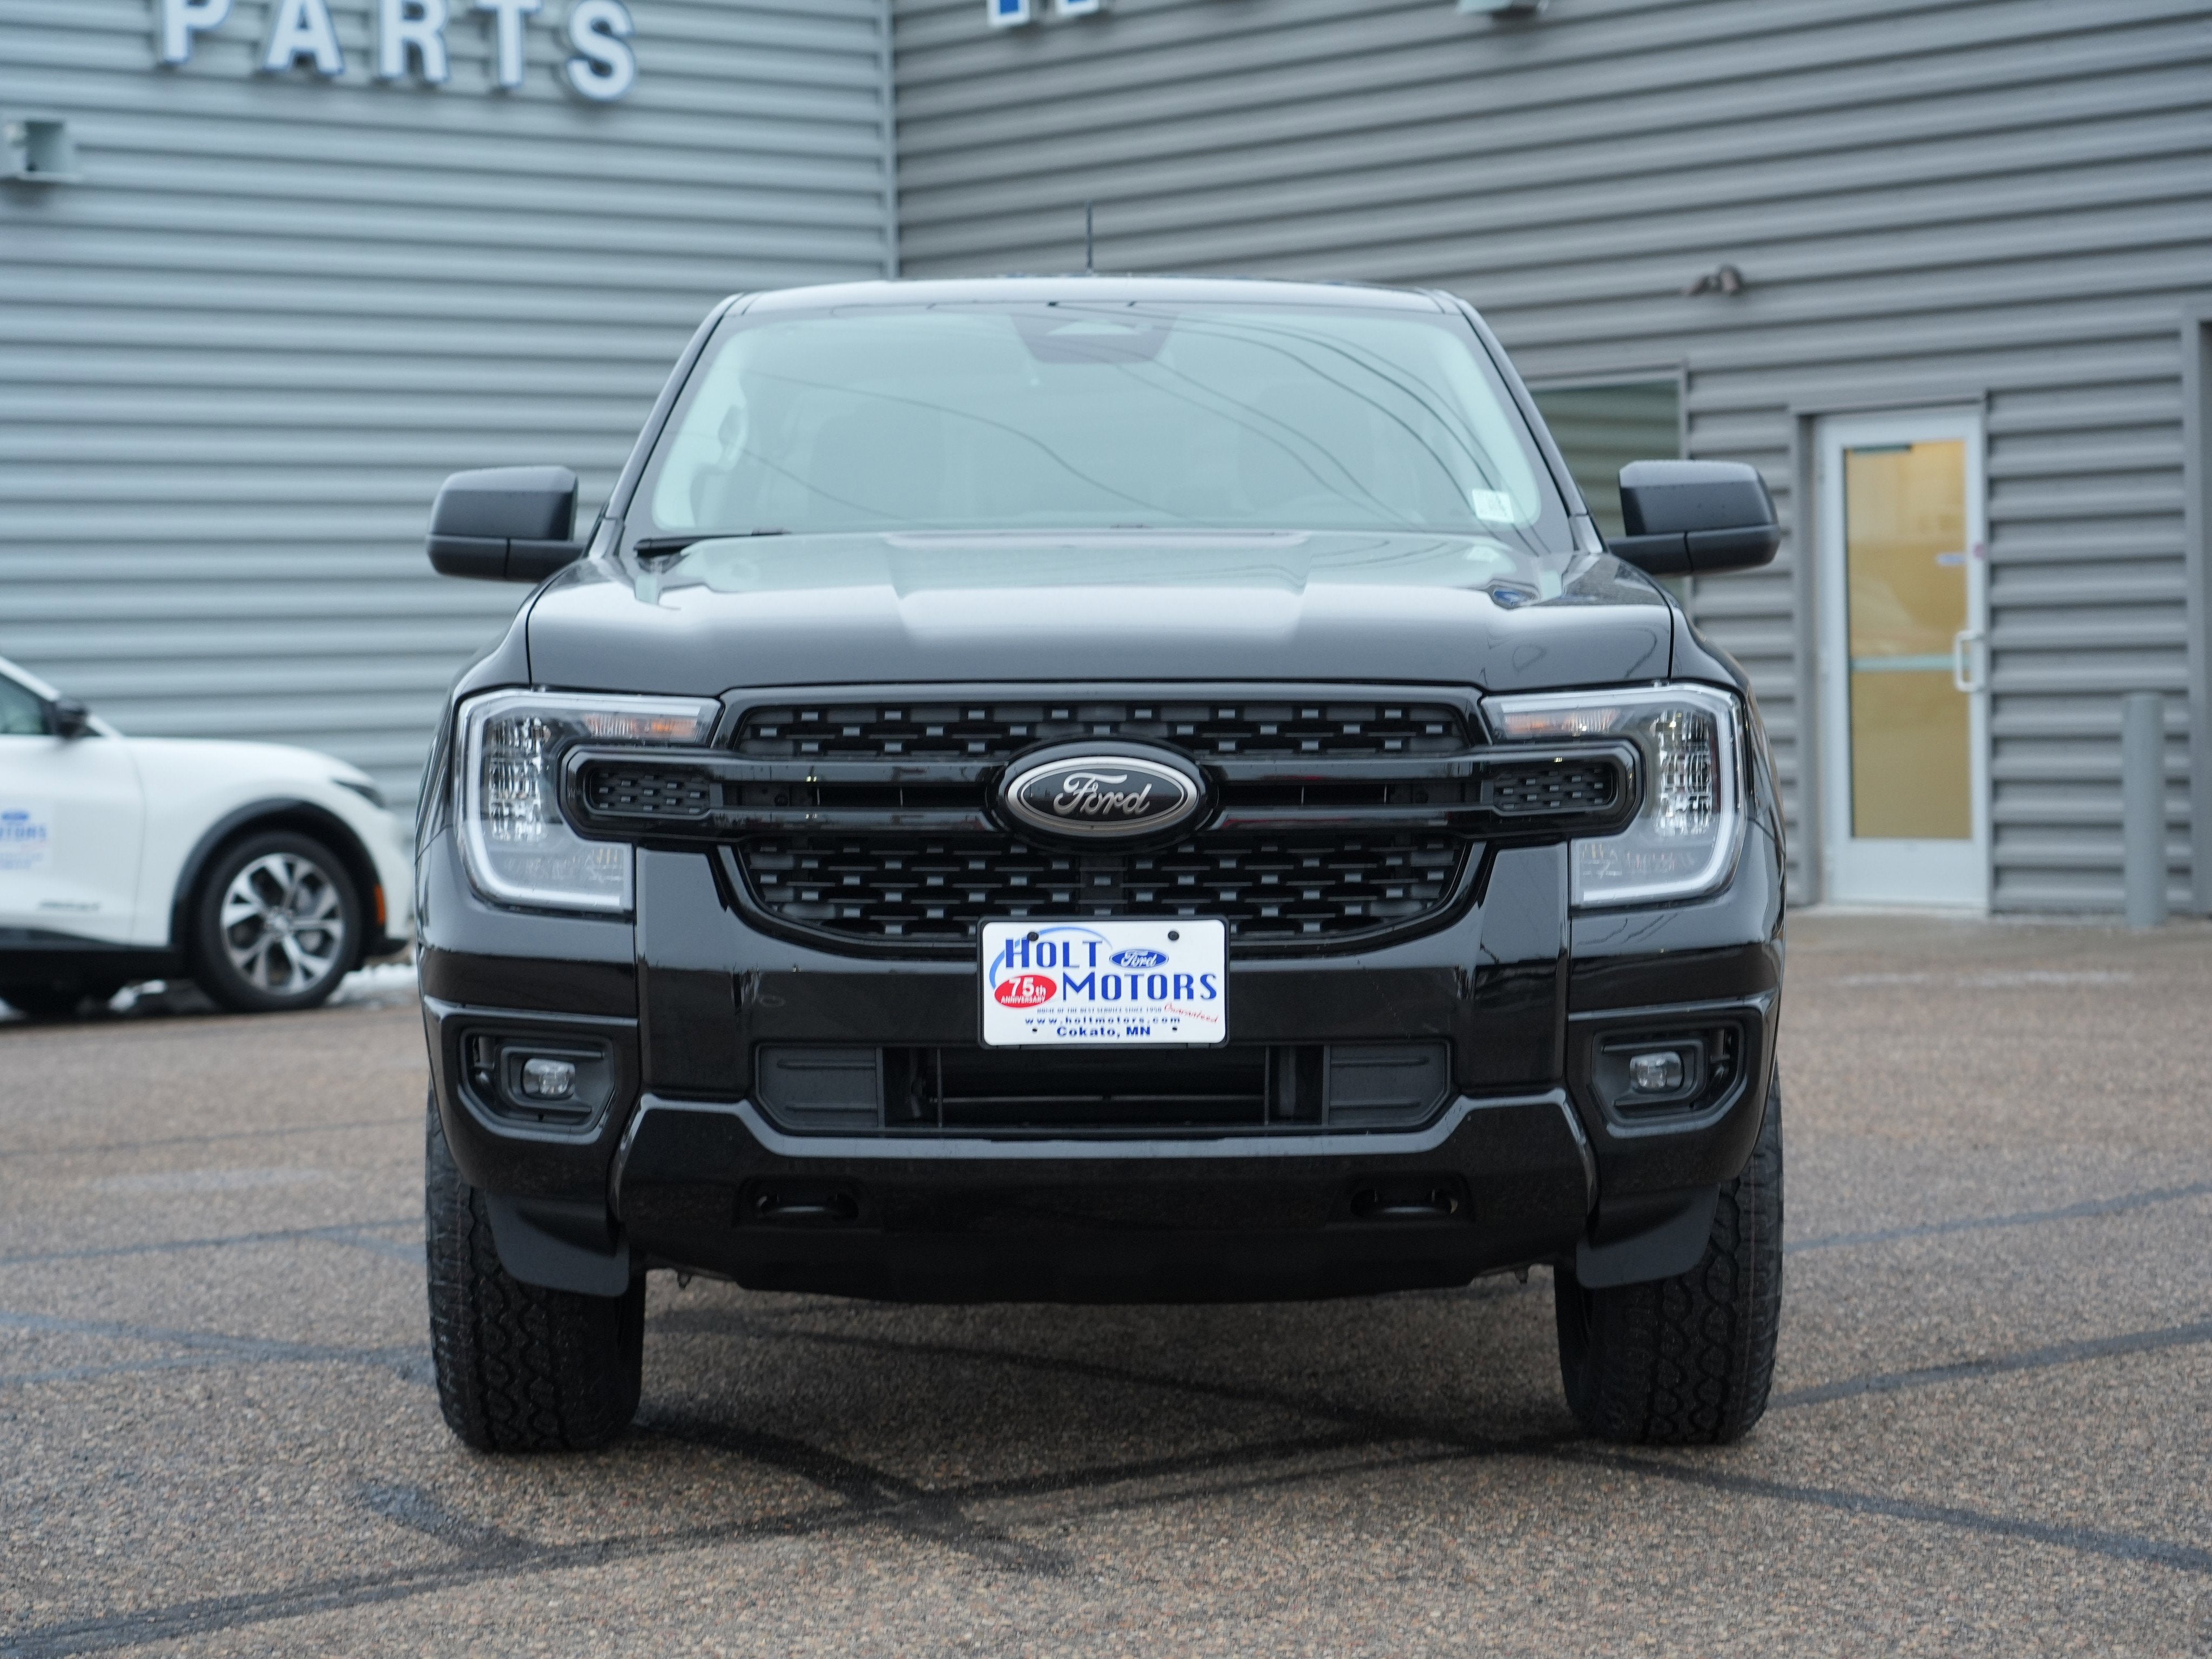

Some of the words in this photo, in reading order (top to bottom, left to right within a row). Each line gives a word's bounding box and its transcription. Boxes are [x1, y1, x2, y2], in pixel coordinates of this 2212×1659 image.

[161, 0, 636, 100] PARTS
[1053, 772, 1152, 815] Ford
[1005, 938, 1103, 969] HOLT
[1121, 950, 1158, 967] Ford
[1008, 977, 1047, 996] 75th
[1062, 972, 1217, 1002] MOTORS
[1000, 995, 1046, 1004] ANNIVERSARY
[1024, 1015, 1181, 1024] www.holtmotors.com
[1056, 1026, 1121, 1038] Cokato,
[1126, 1026, 1151, 1036] MN
